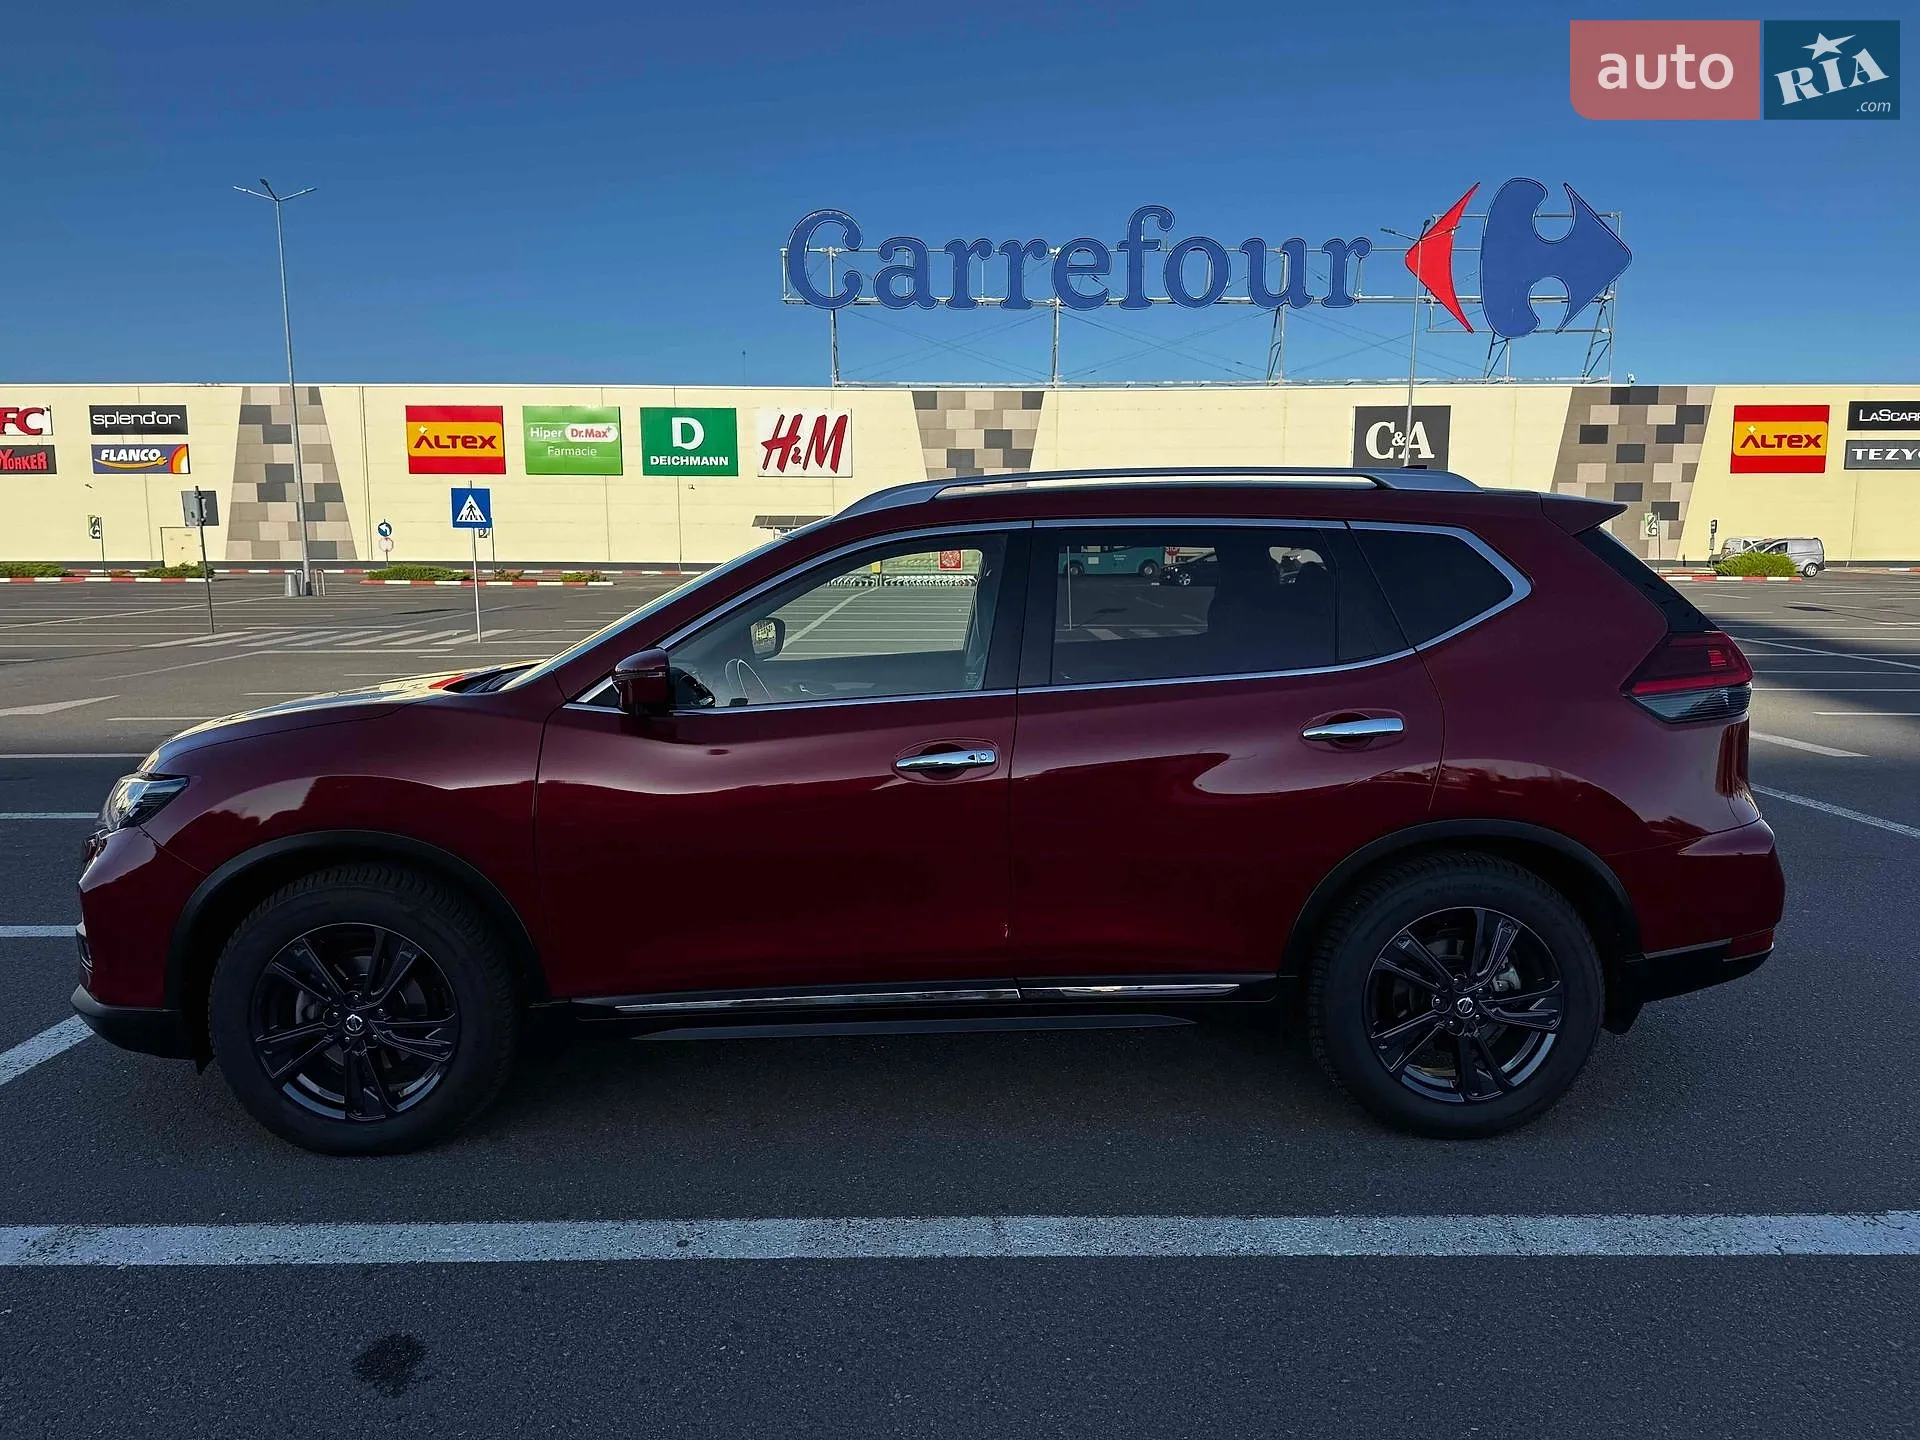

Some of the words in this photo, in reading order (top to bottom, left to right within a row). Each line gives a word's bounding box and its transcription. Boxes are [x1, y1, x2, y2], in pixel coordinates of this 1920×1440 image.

[786, 204, 1372, 310] Carrefour
[530, 427, 562, 439] Hiper
[760, 414, 849, 473] H&M
[1365, 421, 1436, 460] C&A
[100, 449, 161, 462] FLANCO
[547, 446, 598, 457] Farmacie
[1851, 448, 1920, 460] TEZY
[650, 455, 729, 466] DEICHMANN
